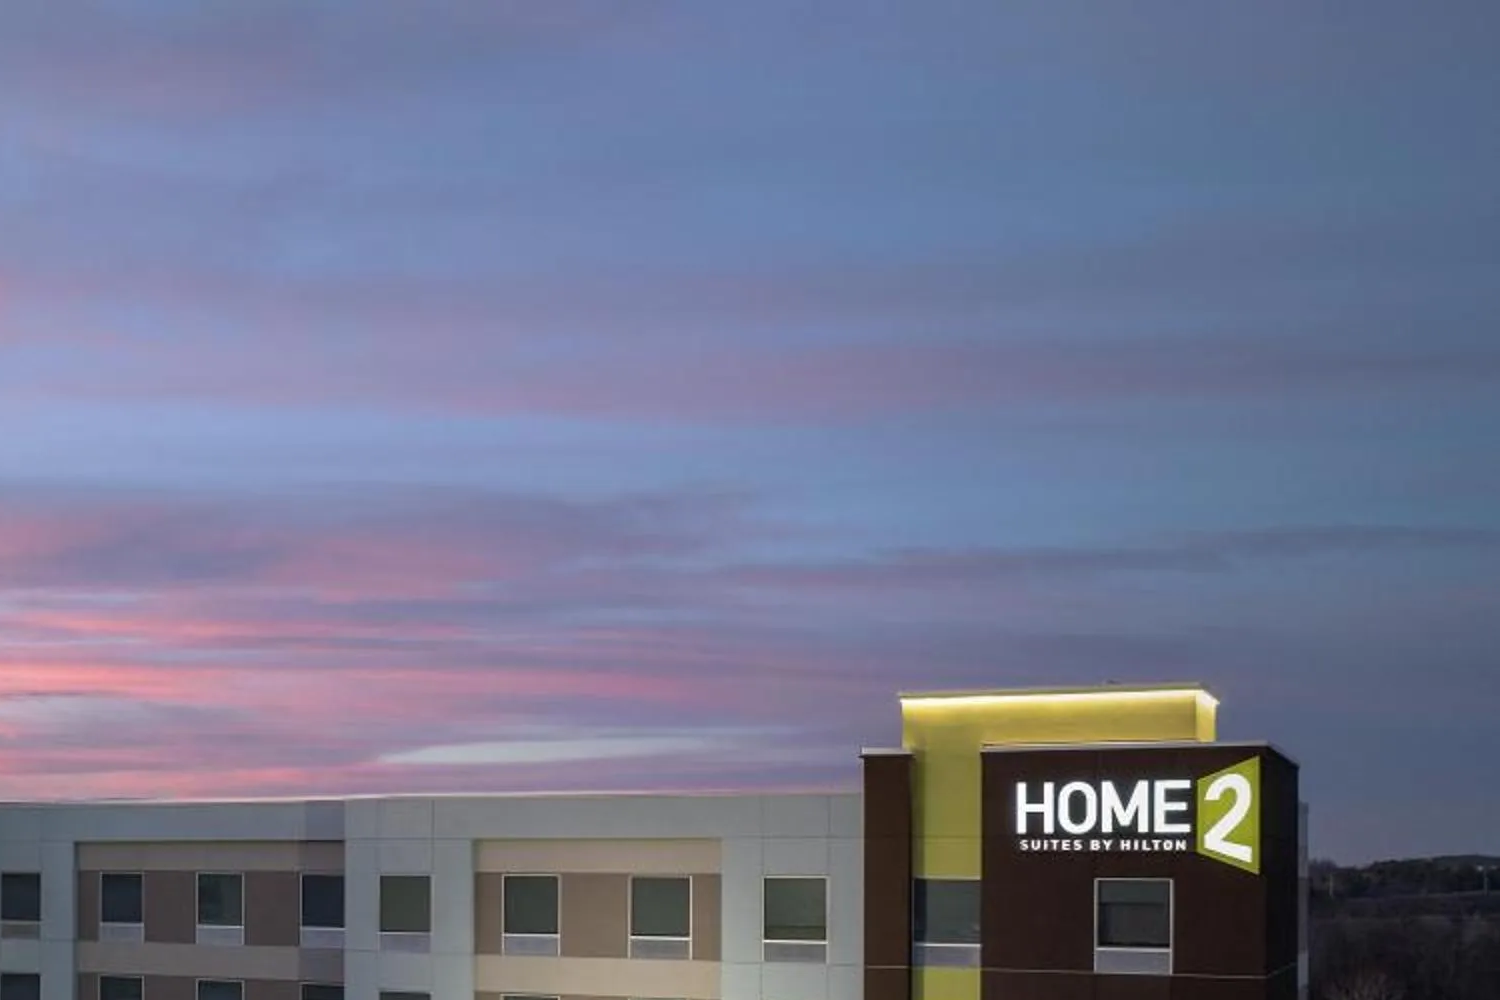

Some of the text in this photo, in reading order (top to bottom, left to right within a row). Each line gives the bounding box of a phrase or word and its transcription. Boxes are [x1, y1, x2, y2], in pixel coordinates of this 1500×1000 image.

[1016, 773, 1252, 863] HOME 2
[1019, 839, 1187, 851] SUITES BY HILTON
